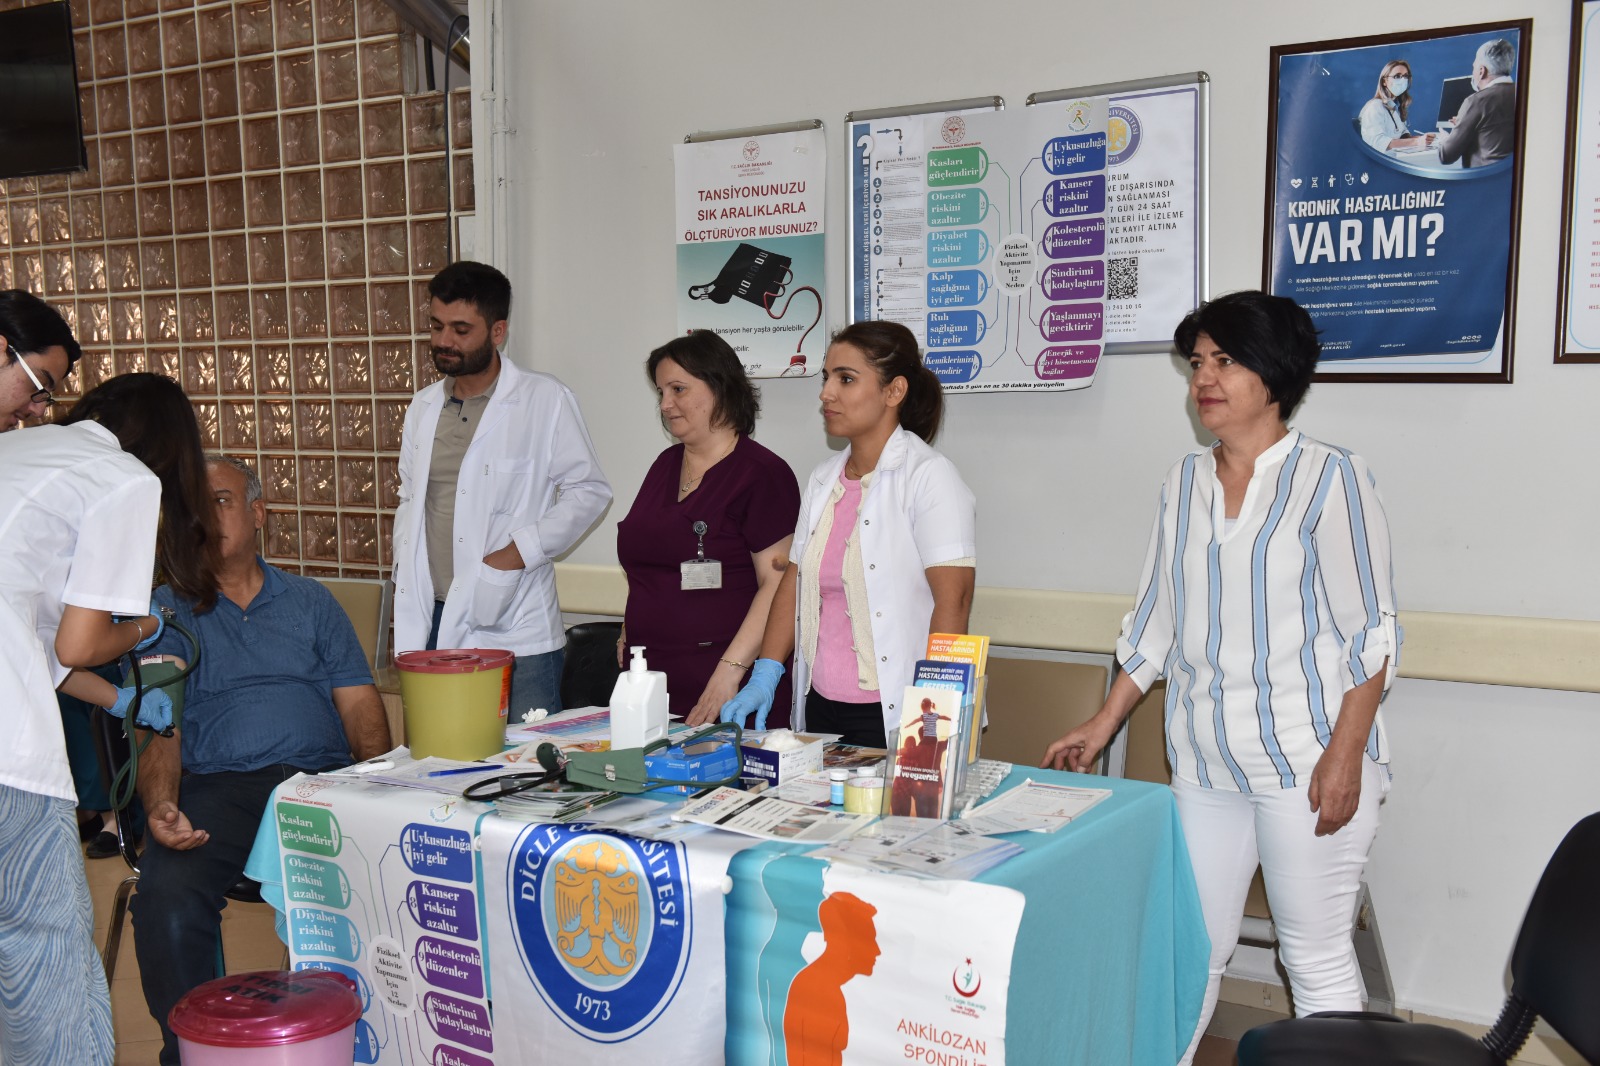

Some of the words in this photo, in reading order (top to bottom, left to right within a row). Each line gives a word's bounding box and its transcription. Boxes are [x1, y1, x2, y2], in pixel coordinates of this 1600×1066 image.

[1054, 137, 1106, 154] Uykusuzluğa
[929, 158, 963, 167] Kasları
[1054, 155, 1065, 168] iyi
[1066, 153, 1086, 167] gelir
[863, 166, 869, 177] MU
[928, 167, 979, 181] güçlendirir
[698, 180, 806, 202] TANSİYONUNUZU
[1059, 180, 1093, 190] Kanser
[1120, 179, 1175, 192] DIŞARISINDA
[931, 192, 967, 201] Obezite
[1059, 190, 1089, 202] riskini
[1116, 190, 1170, 203] SAĞLANMASI
[931, 203, 961, 213] riskini
[1059, 203, 1089, 215] azaltır
[1117, 204, 1134, 213] GÜN
[1137, 203, 1148, 211] 24
[1151, 201, 1171, 210] SAAT
[1288, 198, 1341, 218] KRONİK
[1344, 189, 1446, 214] HASTALIĞINIZ
[697, 208, 717, 221] SIK
[720, 202, 806, 220] ARALIKLARLA
[1138, 212, 1151, 222] İLE
[1153, 210, 1184, 220] İZLEME
[931, 215, 961, 225] azaltır
[684, 226, 756, 243] ÖLÇTÜRÜYOR
[759, 222, 818, 236] MUSUNUZ?
[1053, 221, 1105, 236] Kolesterolü
[1109, 226, 1120, 234] VE
[1122, 224, 1145, 233] KAYIT
[1148, 222, 1177, 231] ALTINA
[862, 227, 870, 252] KİŞİSEL
[931, 230, 968, 242] Diyabet
[1052, 236, 1093, 248] düzenler
[1107, 235, 1147, 245] AKTADIR.
[1288, 218, 1363, 265] VAR
[1372, 212, 1445, 261] MI?
[932, 243, 961, 252] riskini
[932, 255, 962, 264] azaltır
[931, 271, 953, 282] Kalp
[1051, 266, 1094, 278] Sindirimi
[931, 283, 970, 294] sağlığına
[1052, 278, 1105, 290] kolaylaştırır
[931, 296, 942, 306] iyi
[944, 294, 965, 305] gelir
[930, 312, 949, 322] Ruh
[1050, 311, 1101, 323] Yaşlanmayı
[715, 326, 741, 336] tansiyon
[742, 325, 752, 333] her
[753, 325, 770, 335] yaşta
[772, 324, 805, 334] görülebilir.
[930, 323, 968, 335] sağlığına
[1049, 322, 1093, 335] geciktirir
[930, 336, 940, 347] iyi
[942, 335, 963, 346] gelir
[930, 644, 975, 654] HASTALARINDA
[917, 671, 963, 681] HASTALARINDA
[909, 772, 939, 782] egzersiz
[279, 812, 313, 828] Kasları
[281, 829, 333, 847] güçlendirir
[411, 829, 472, 854] Uykusuzluğa
[412, 847, 425, 865] iyi
[426, 851, 448, 867] gelir
[288, 857, 325, 873] Obezite
[519, 825, 561, 904] DİCLE
[291, 872, 323, 888] riskini
[293, 889, 326, 902] azaltır
[421, 883, 460, 902] Kanser
[423, 900, 457, 918] riskini
[294, 908, 337, 924] Diyabet
[298, 924, 334, 938] riskini
[426, 919, 459, 934] azaltır
[300, 940, 337, 953] azaltır
[376, 946, 401, 960] Fiziksel
[424, 940, 481, 967] Kolesterolü
[378, 957, 403, 970] Aktivite
[426, 958, 469, 980] düzenler
[385, 977, 399, 989] İçin
[387, 996, 408, 1009] Neden
[431, 997, 478, 1021] Sindirimi
[574, 992, 612, 1021] 1973
[435, 1011, 492, 1038] kolaylaştırır
[896, 1018, 986, 1056] ANKİLOZAN
